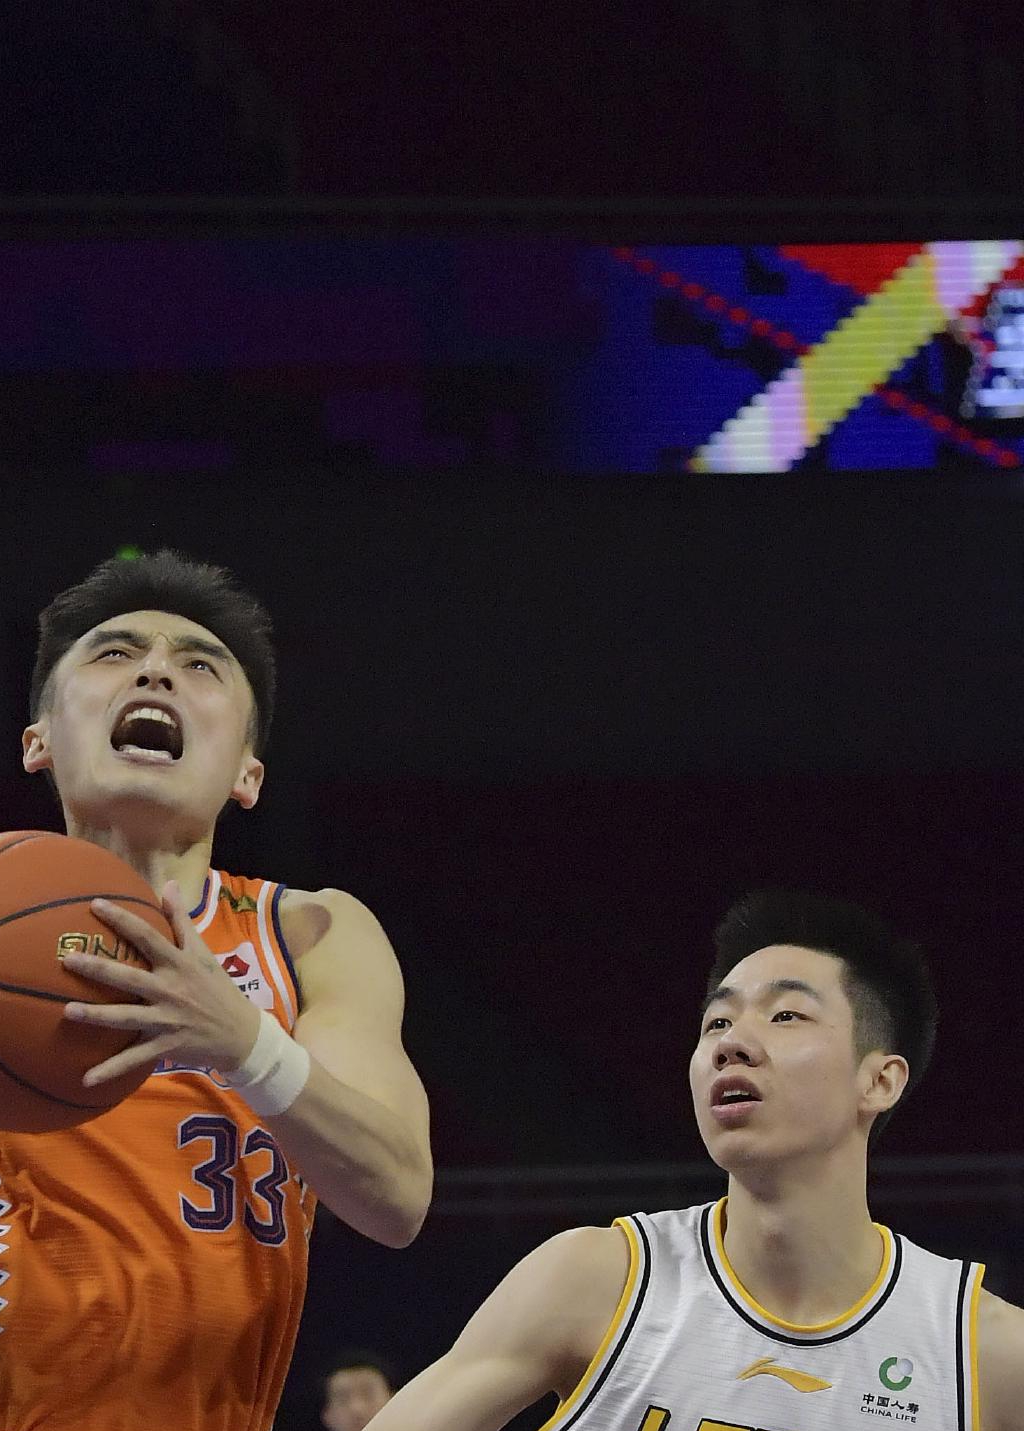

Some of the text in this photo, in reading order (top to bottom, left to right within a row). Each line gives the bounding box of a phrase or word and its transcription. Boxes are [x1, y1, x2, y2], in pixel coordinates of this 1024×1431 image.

[177, 1113, 289, 1247] 33
[862, 1393, 920, 1414] 中国人寿
[860, 1406, 917, 1423] CHINA LIFE
